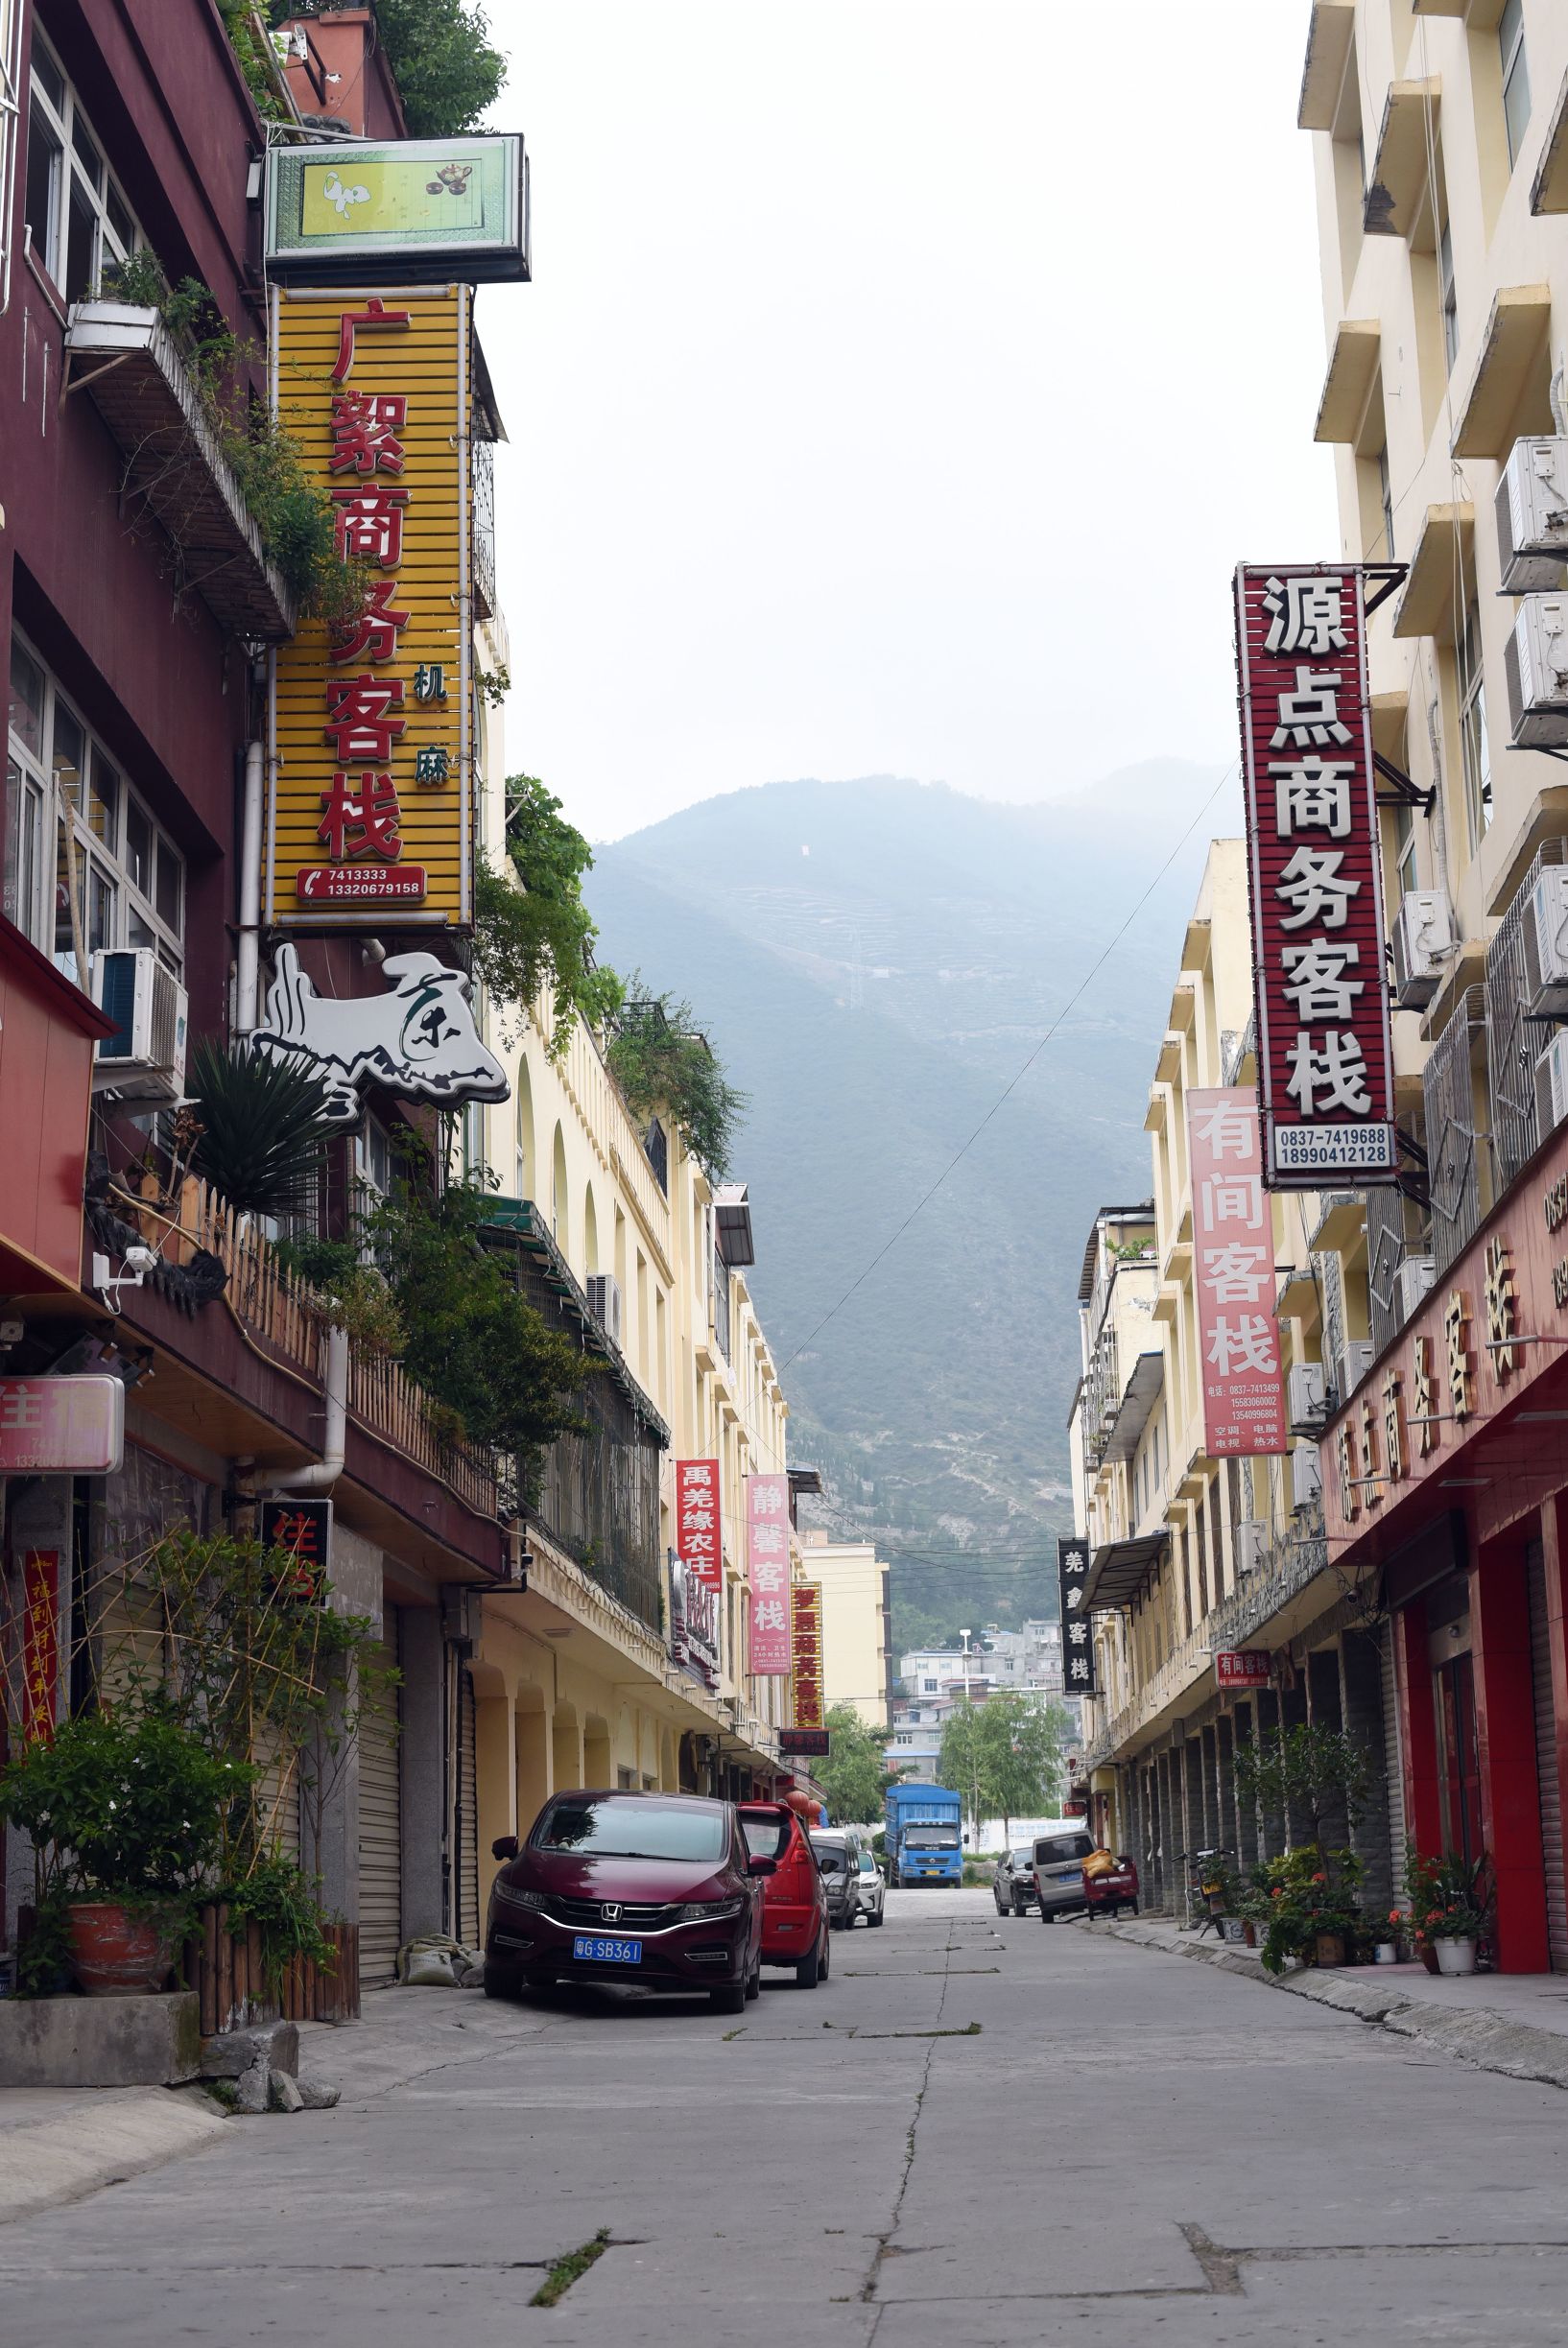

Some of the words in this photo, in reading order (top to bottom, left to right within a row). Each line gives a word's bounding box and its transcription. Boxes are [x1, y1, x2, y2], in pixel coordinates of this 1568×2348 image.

[413, 663, 449, 786] 机麻
[1262, 576, 1372, 1116] 源点商务客栈
[328, 869, 388, 881] 7413333
[327, 882, 419, 895] 13320679158
[1280, 1128, 1386, 1147] 0837-7419688
[1281, 1147, 1387, 1164] 18990412128
[1194, 1100, 1278, 1378] 有间客栈
[1229, 1383, 1280, 1395] 0837-7413499
[682, 1465, 715, 1576] 禹羌缘农庄
[752, 1484, 785, 1631] 静馨客栈
[1221, 1654, 1268, 1675] 有间客栈
